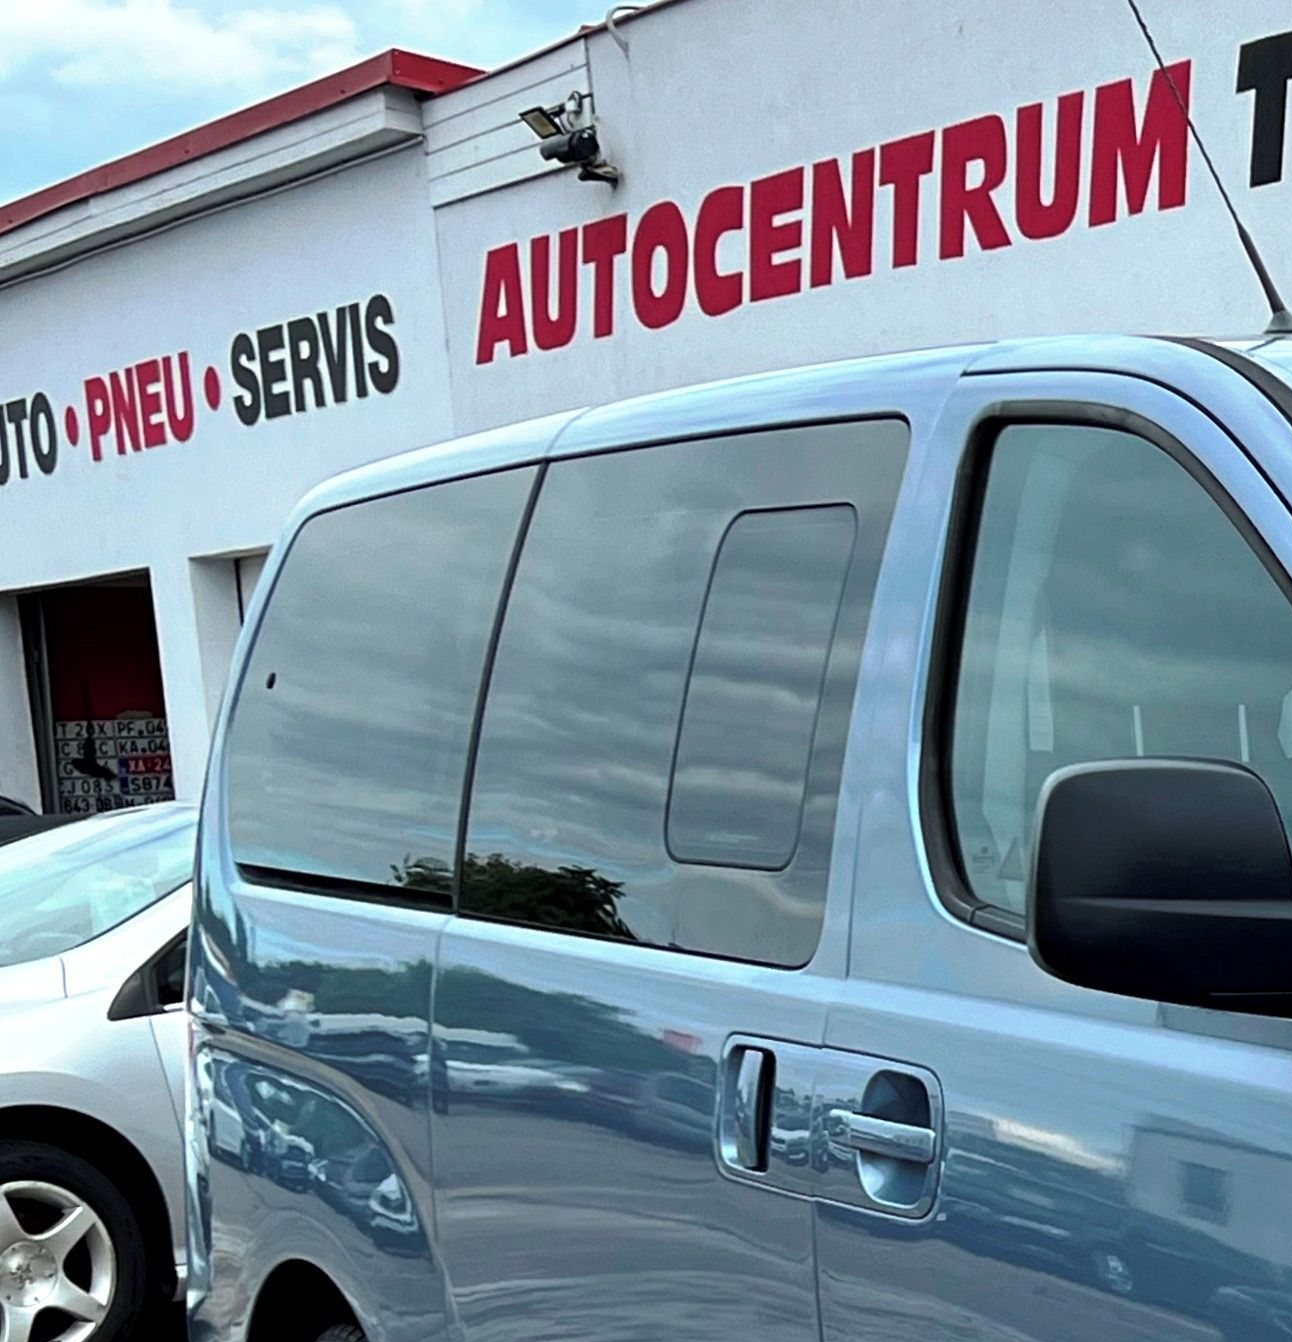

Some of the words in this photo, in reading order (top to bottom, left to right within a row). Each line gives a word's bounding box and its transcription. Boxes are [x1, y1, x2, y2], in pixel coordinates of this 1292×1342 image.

[476, 59, 1192, 365] AUTOCENTRUM
[84, 350, 195, 461] PNEU
[231, 294, 400, 426] SERVIS
